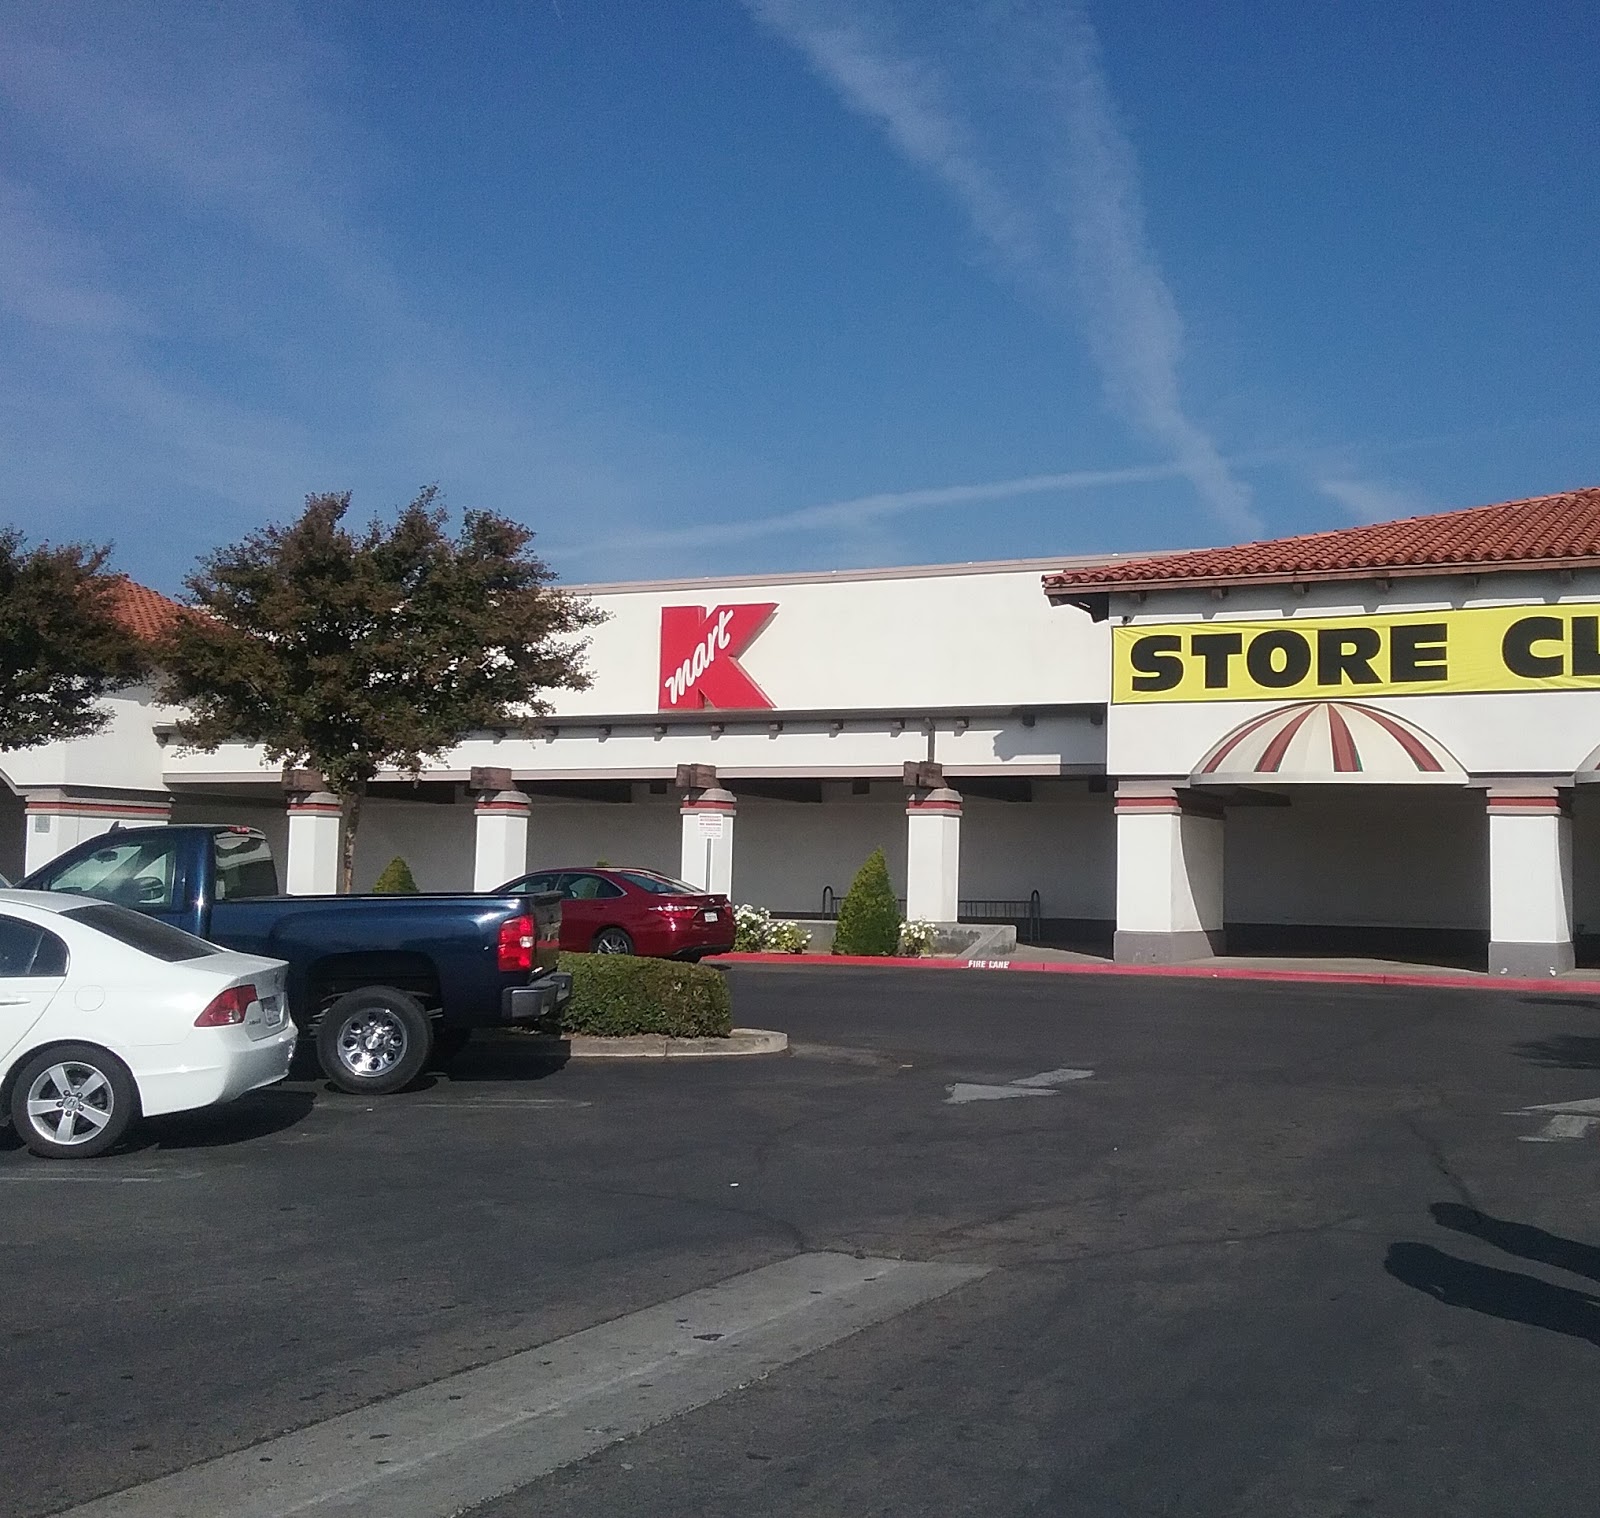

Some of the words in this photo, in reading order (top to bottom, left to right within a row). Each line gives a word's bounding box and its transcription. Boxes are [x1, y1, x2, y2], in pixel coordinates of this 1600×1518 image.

[658, 603, 779, 710] K
[665, 609, 734, 704] mart
[1130, 623, 1449, 692] STORE
[968, 960, 987, 968] FIRE
[988, 960, 1010, 969] LANE
